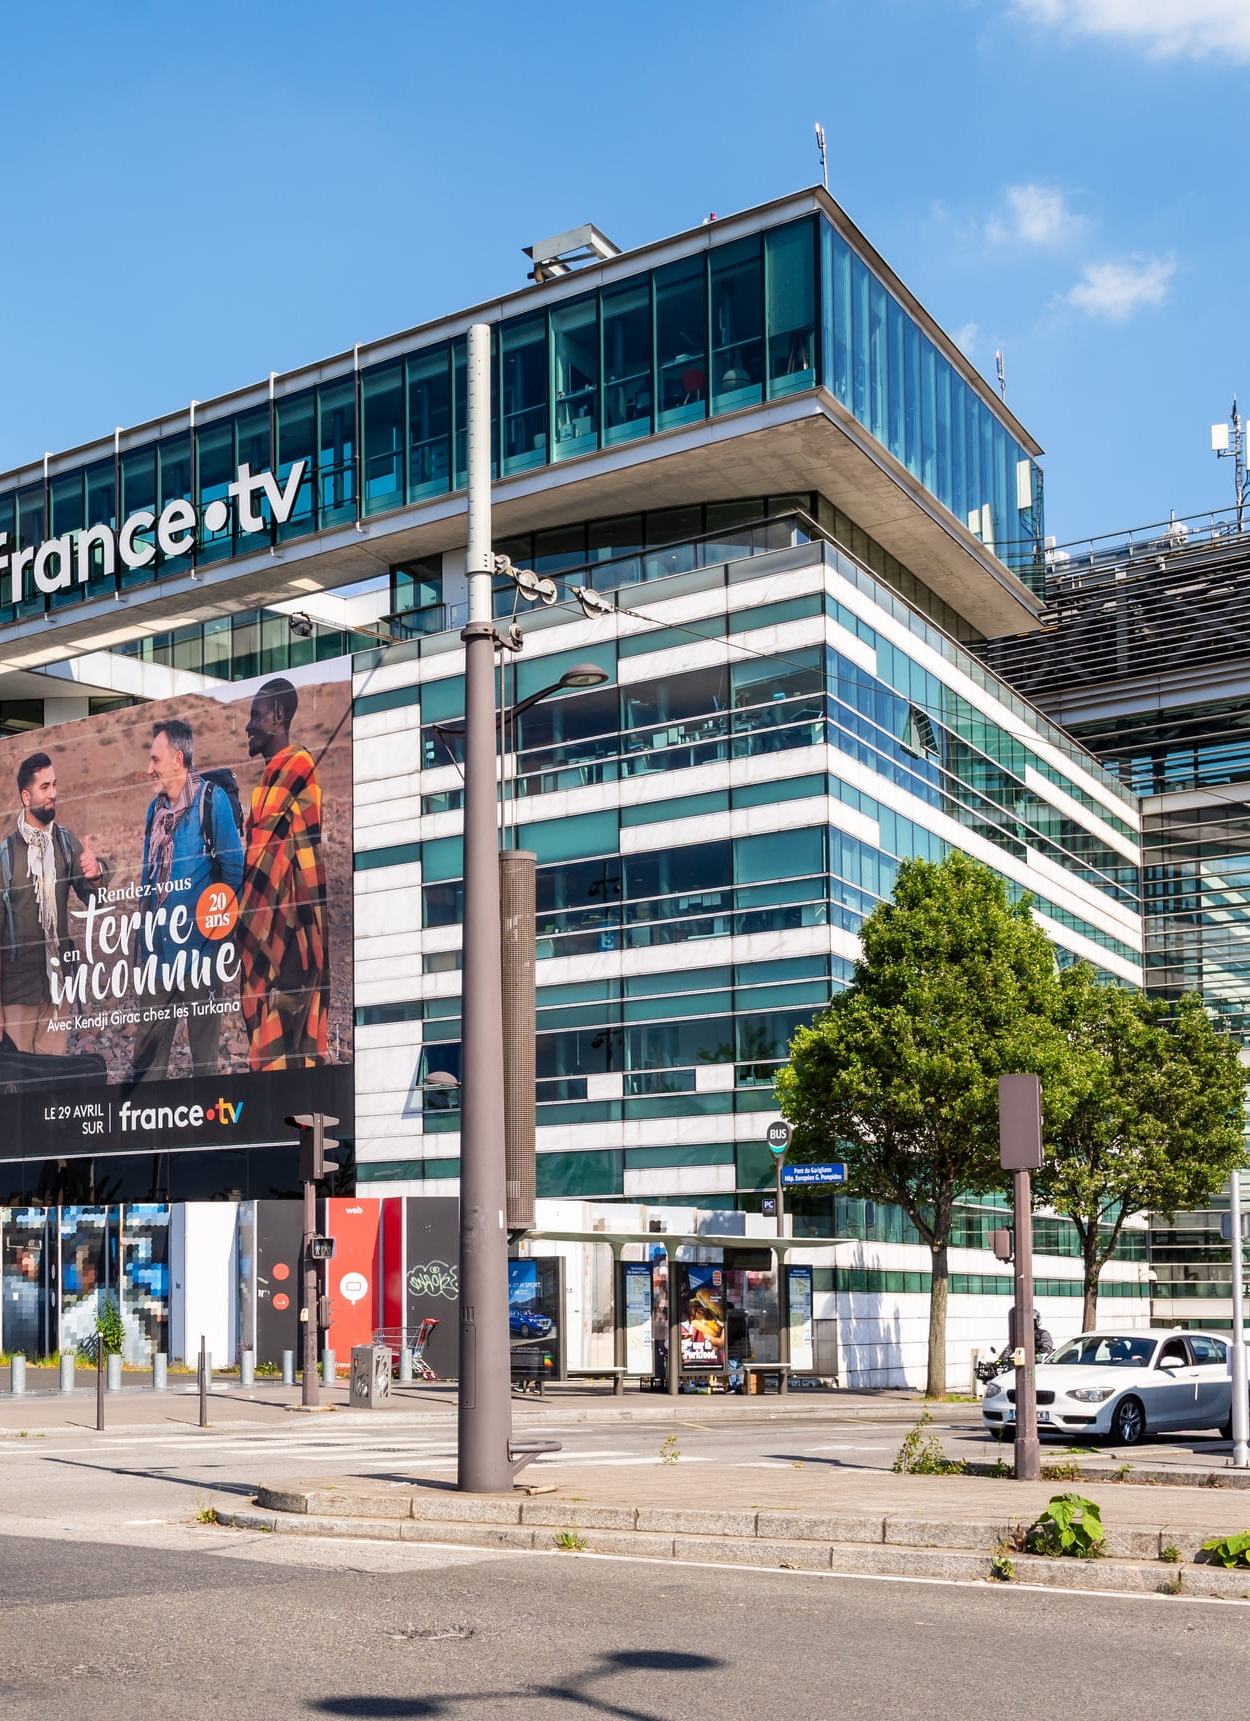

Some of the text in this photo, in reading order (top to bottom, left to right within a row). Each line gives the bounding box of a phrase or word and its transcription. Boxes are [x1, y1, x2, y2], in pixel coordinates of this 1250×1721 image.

[97, 877, 192, 903] Rendez-vous
[209, 891, 227, 912] 20
[205, 911, 230, 929] ans
[63, 949, 80, 963] en
[50, 942, 241, 1005] inconnue
[47, 1000, 241, 1033] Avec Kendji Girac chez les Turkana
[44, 1103, 104, 1121] LE 29 AVRIL
[82, 1121, 104, 1135] SUR
[770, 1128, 787, 1140] BUS
[345, 1205, 364, 1214] web
[764, 1200, 774, 1208] PC
